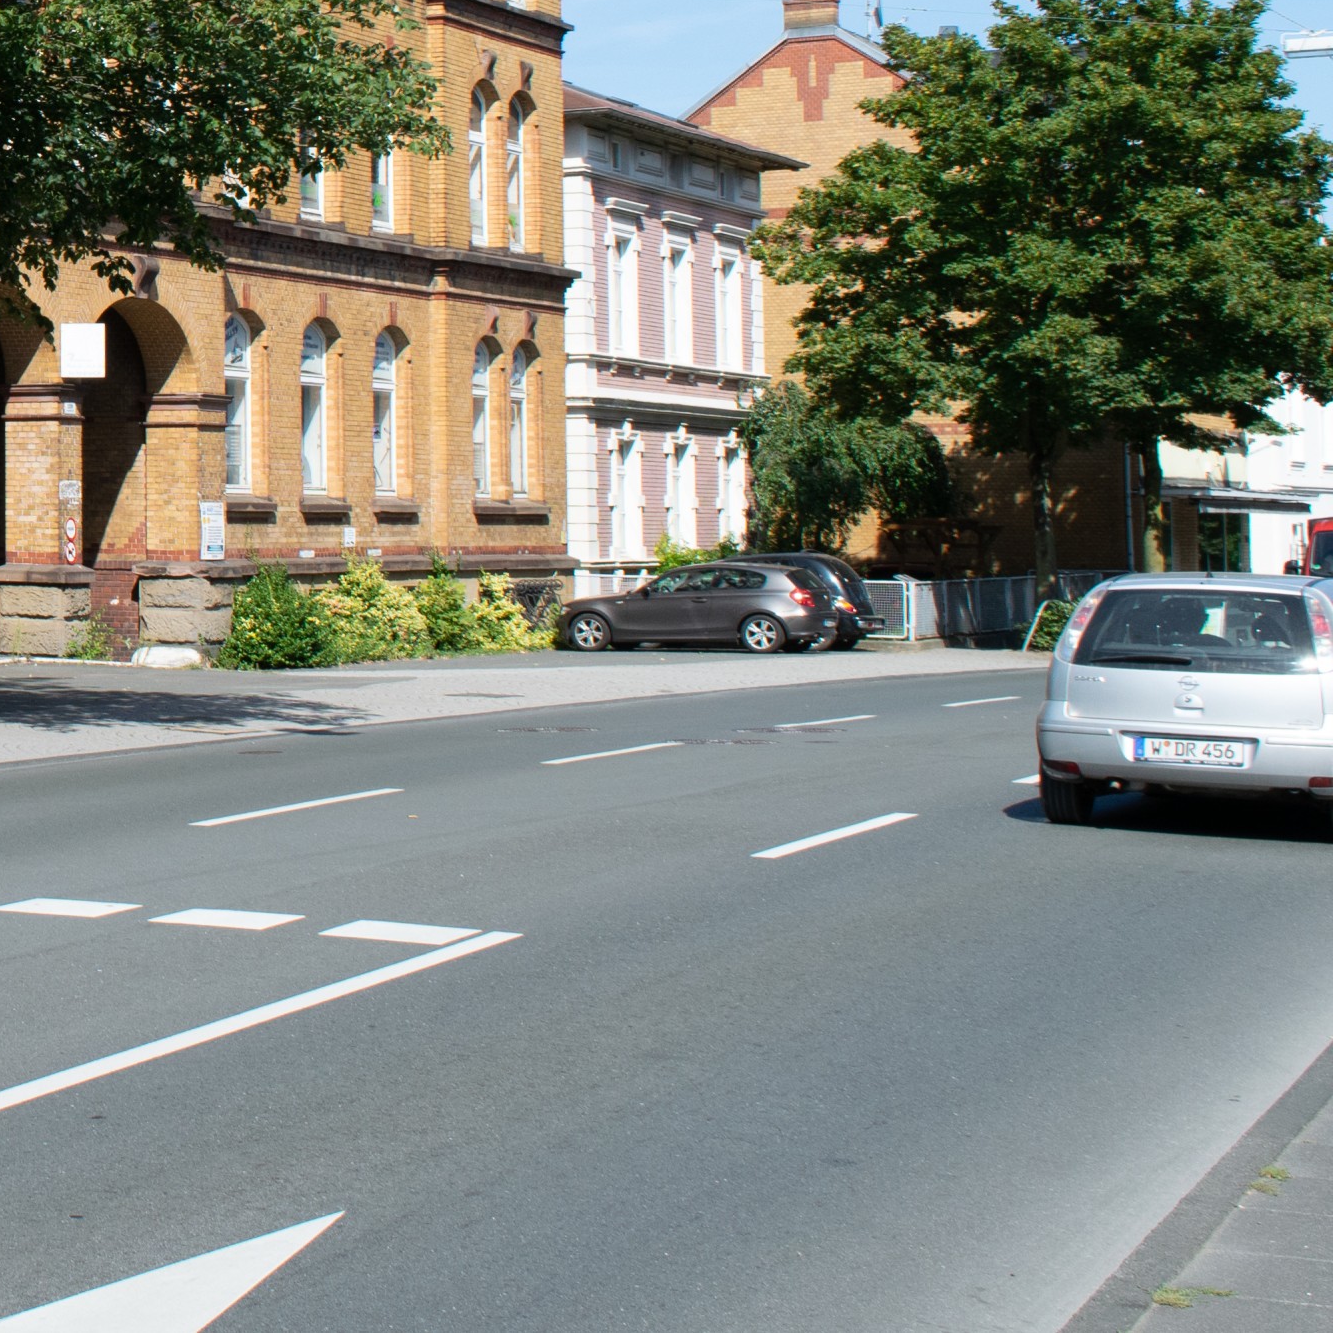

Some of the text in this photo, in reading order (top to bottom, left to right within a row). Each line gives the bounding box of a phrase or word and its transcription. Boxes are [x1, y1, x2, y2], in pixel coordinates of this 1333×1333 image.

[1151, 740, 1235, 759] W DR 456
